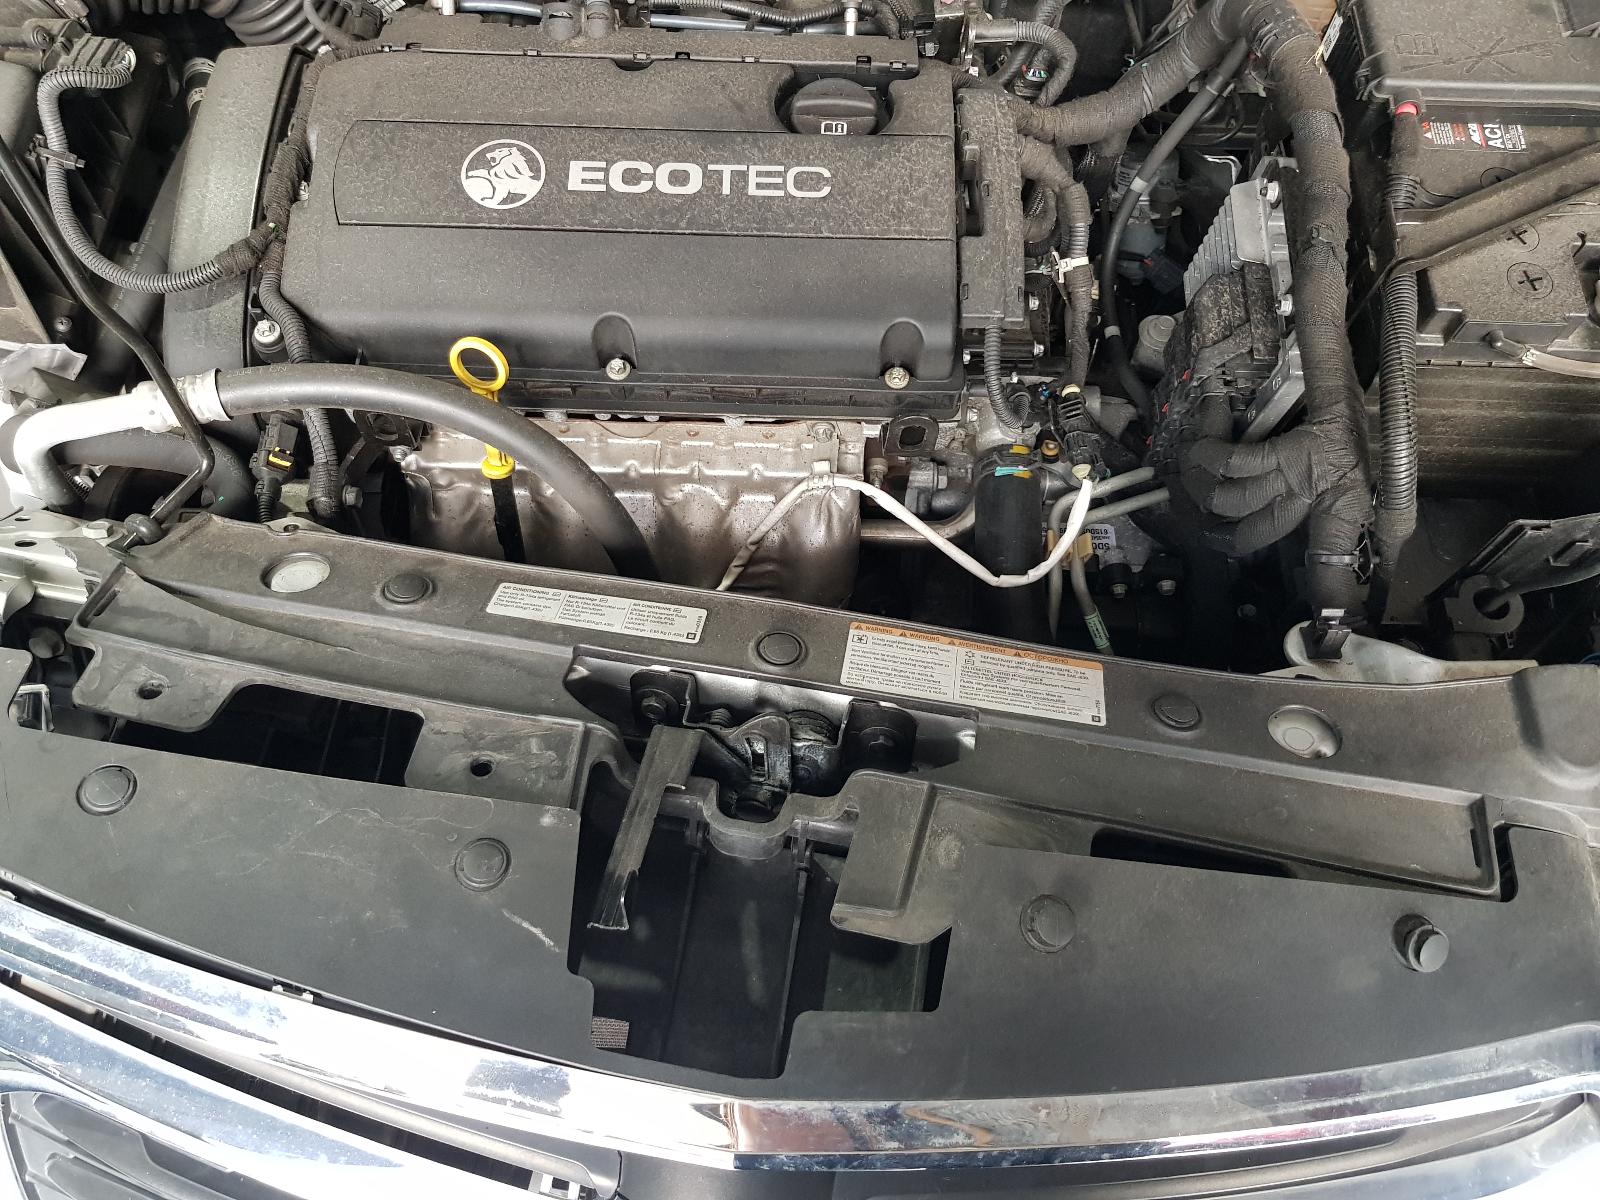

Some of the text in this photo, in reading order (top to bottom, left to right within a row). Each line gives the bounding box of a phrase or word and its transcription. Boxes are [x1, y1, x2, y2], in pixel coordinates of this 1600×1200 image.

[567, 160, 832, 198] ECOTEC
[865, 625, 892, 634] WARNING
[909, 632, 940, 641] WARNUNG
[958, 641, 1005, 653] AVERTISSEMENT
